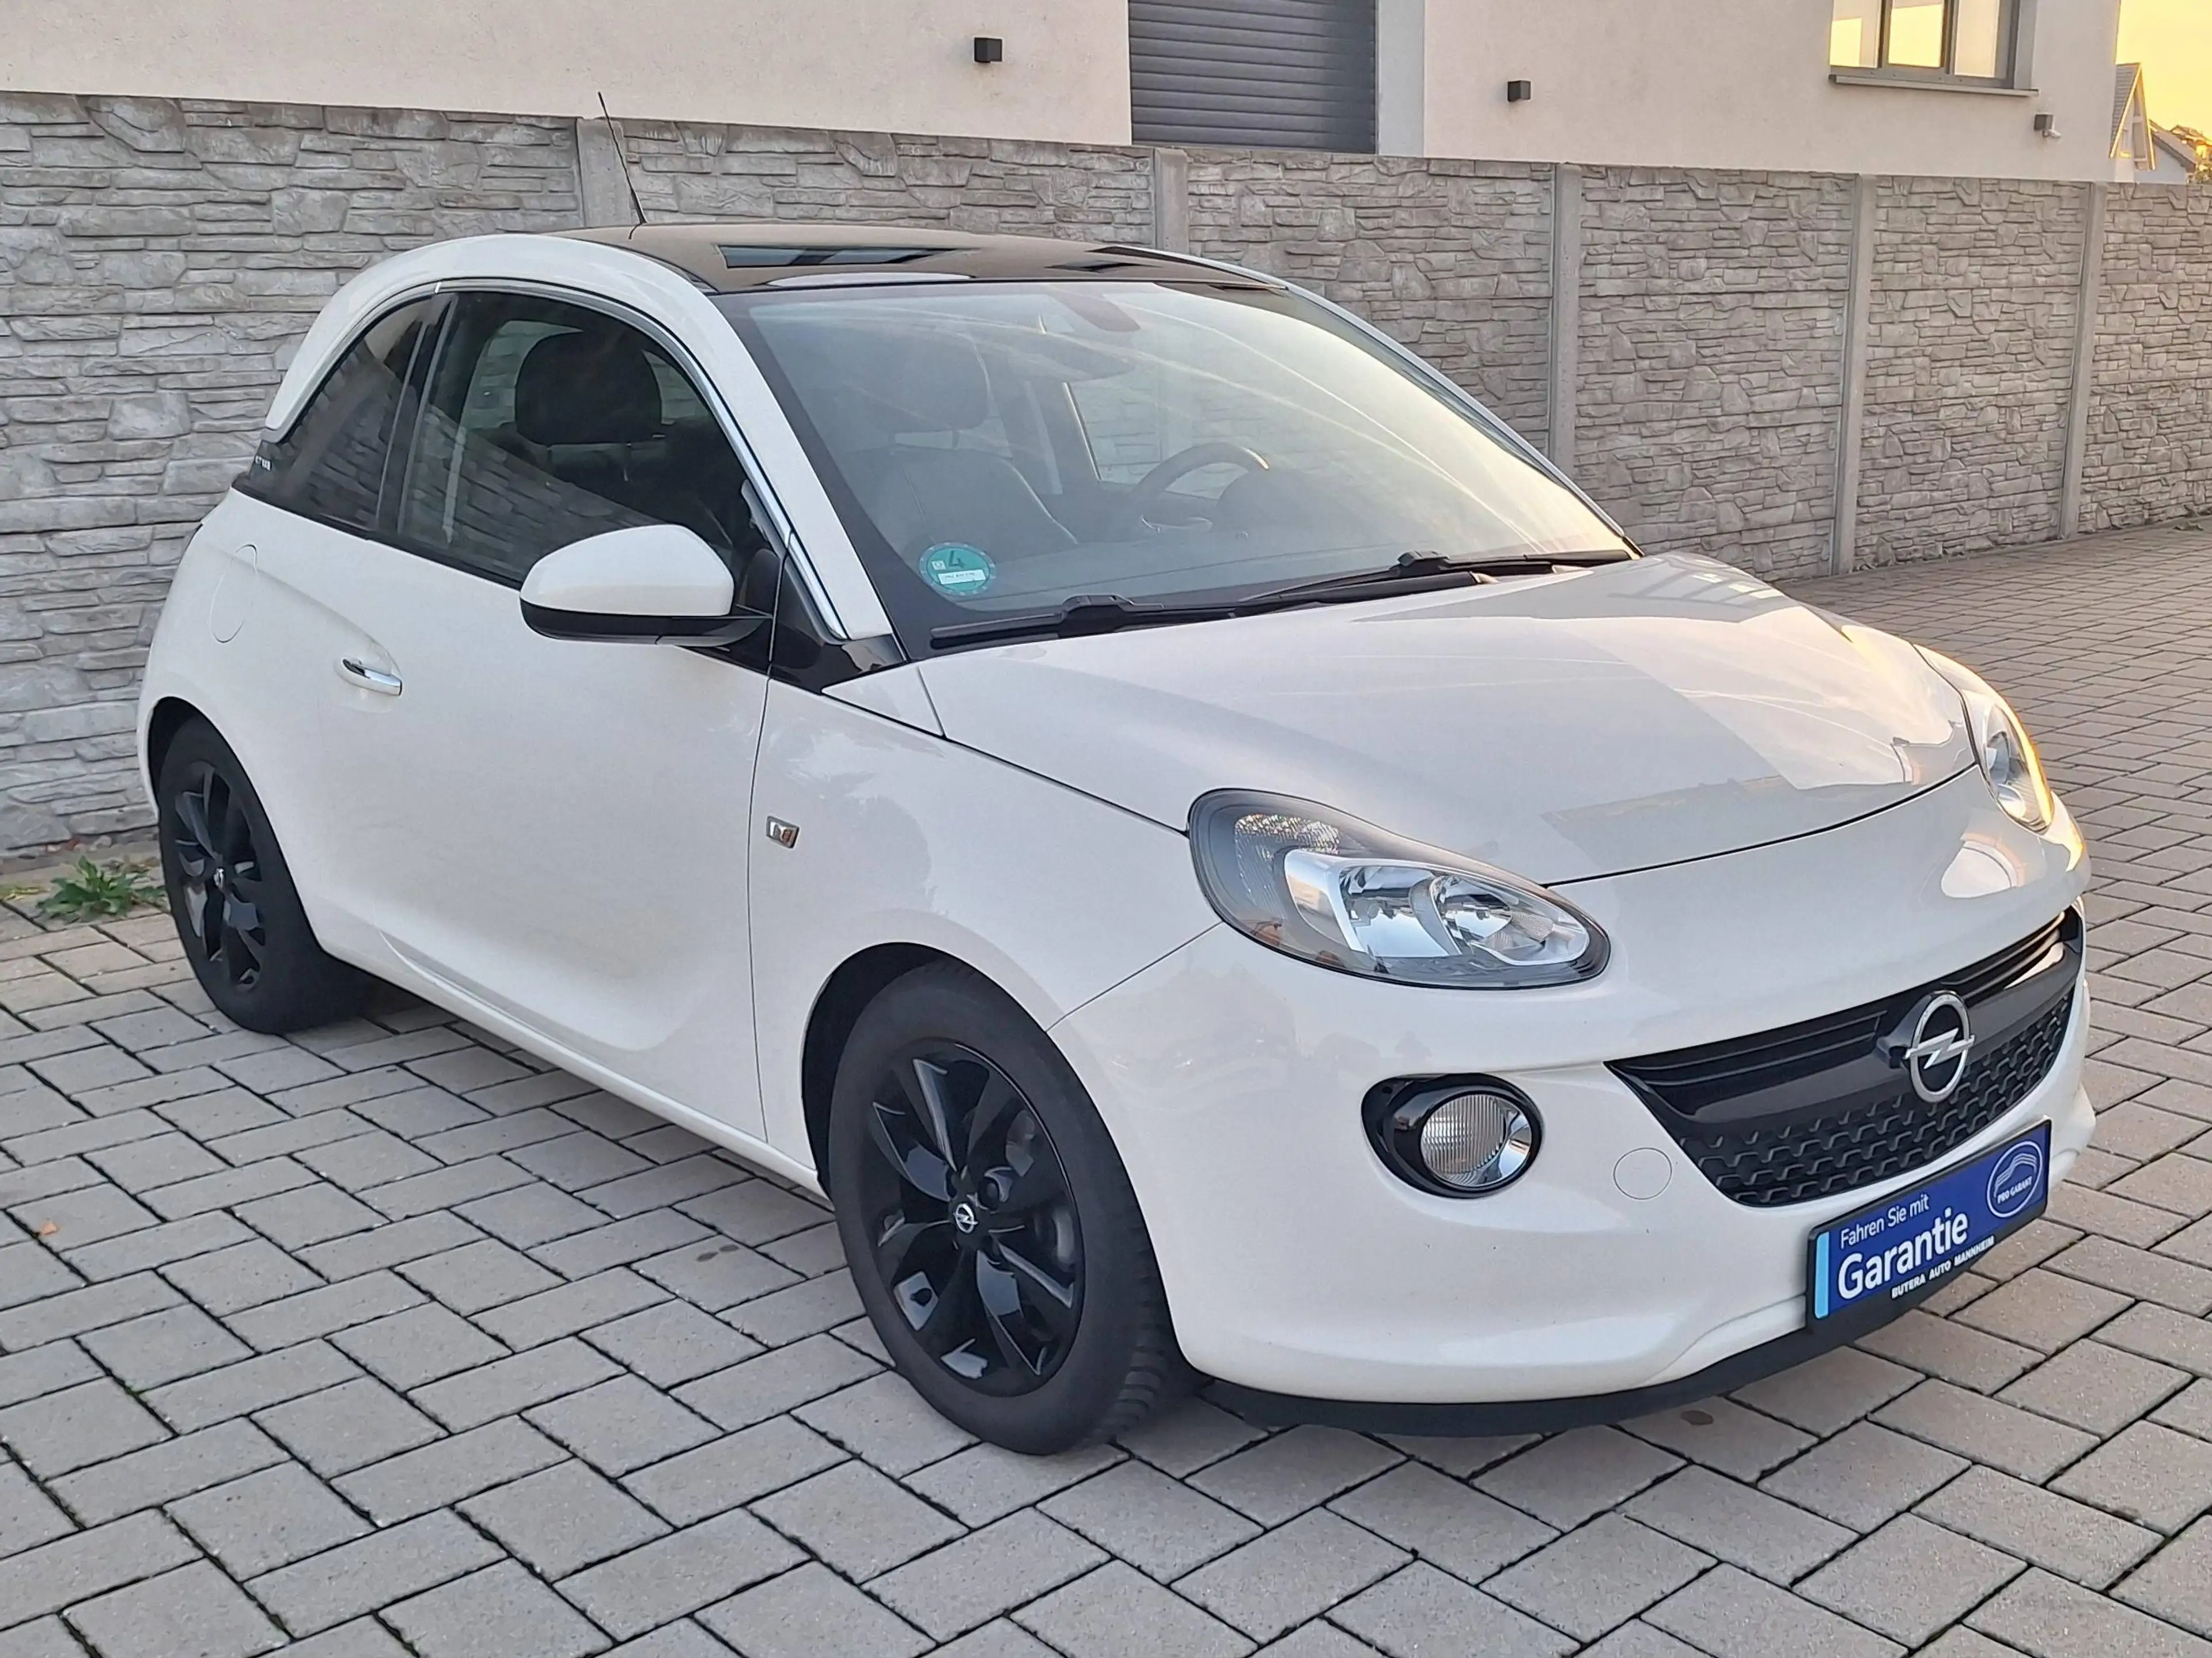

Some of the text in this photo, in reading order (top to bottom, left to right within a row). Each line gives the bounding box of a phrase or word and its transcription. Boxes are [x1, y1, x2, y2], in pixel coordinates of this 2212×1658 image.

[949, 549, 966, 569] 4
[1997, 1175, 2033, 1204] PRO GARANT
[1840, 1193, 1930, 1249] Fahren Sie mit
[1838, 1207, 1968, 1300] Garantie
[1891, 1235, 1995, 1299] BUTERA AUTO MANNHEIM
